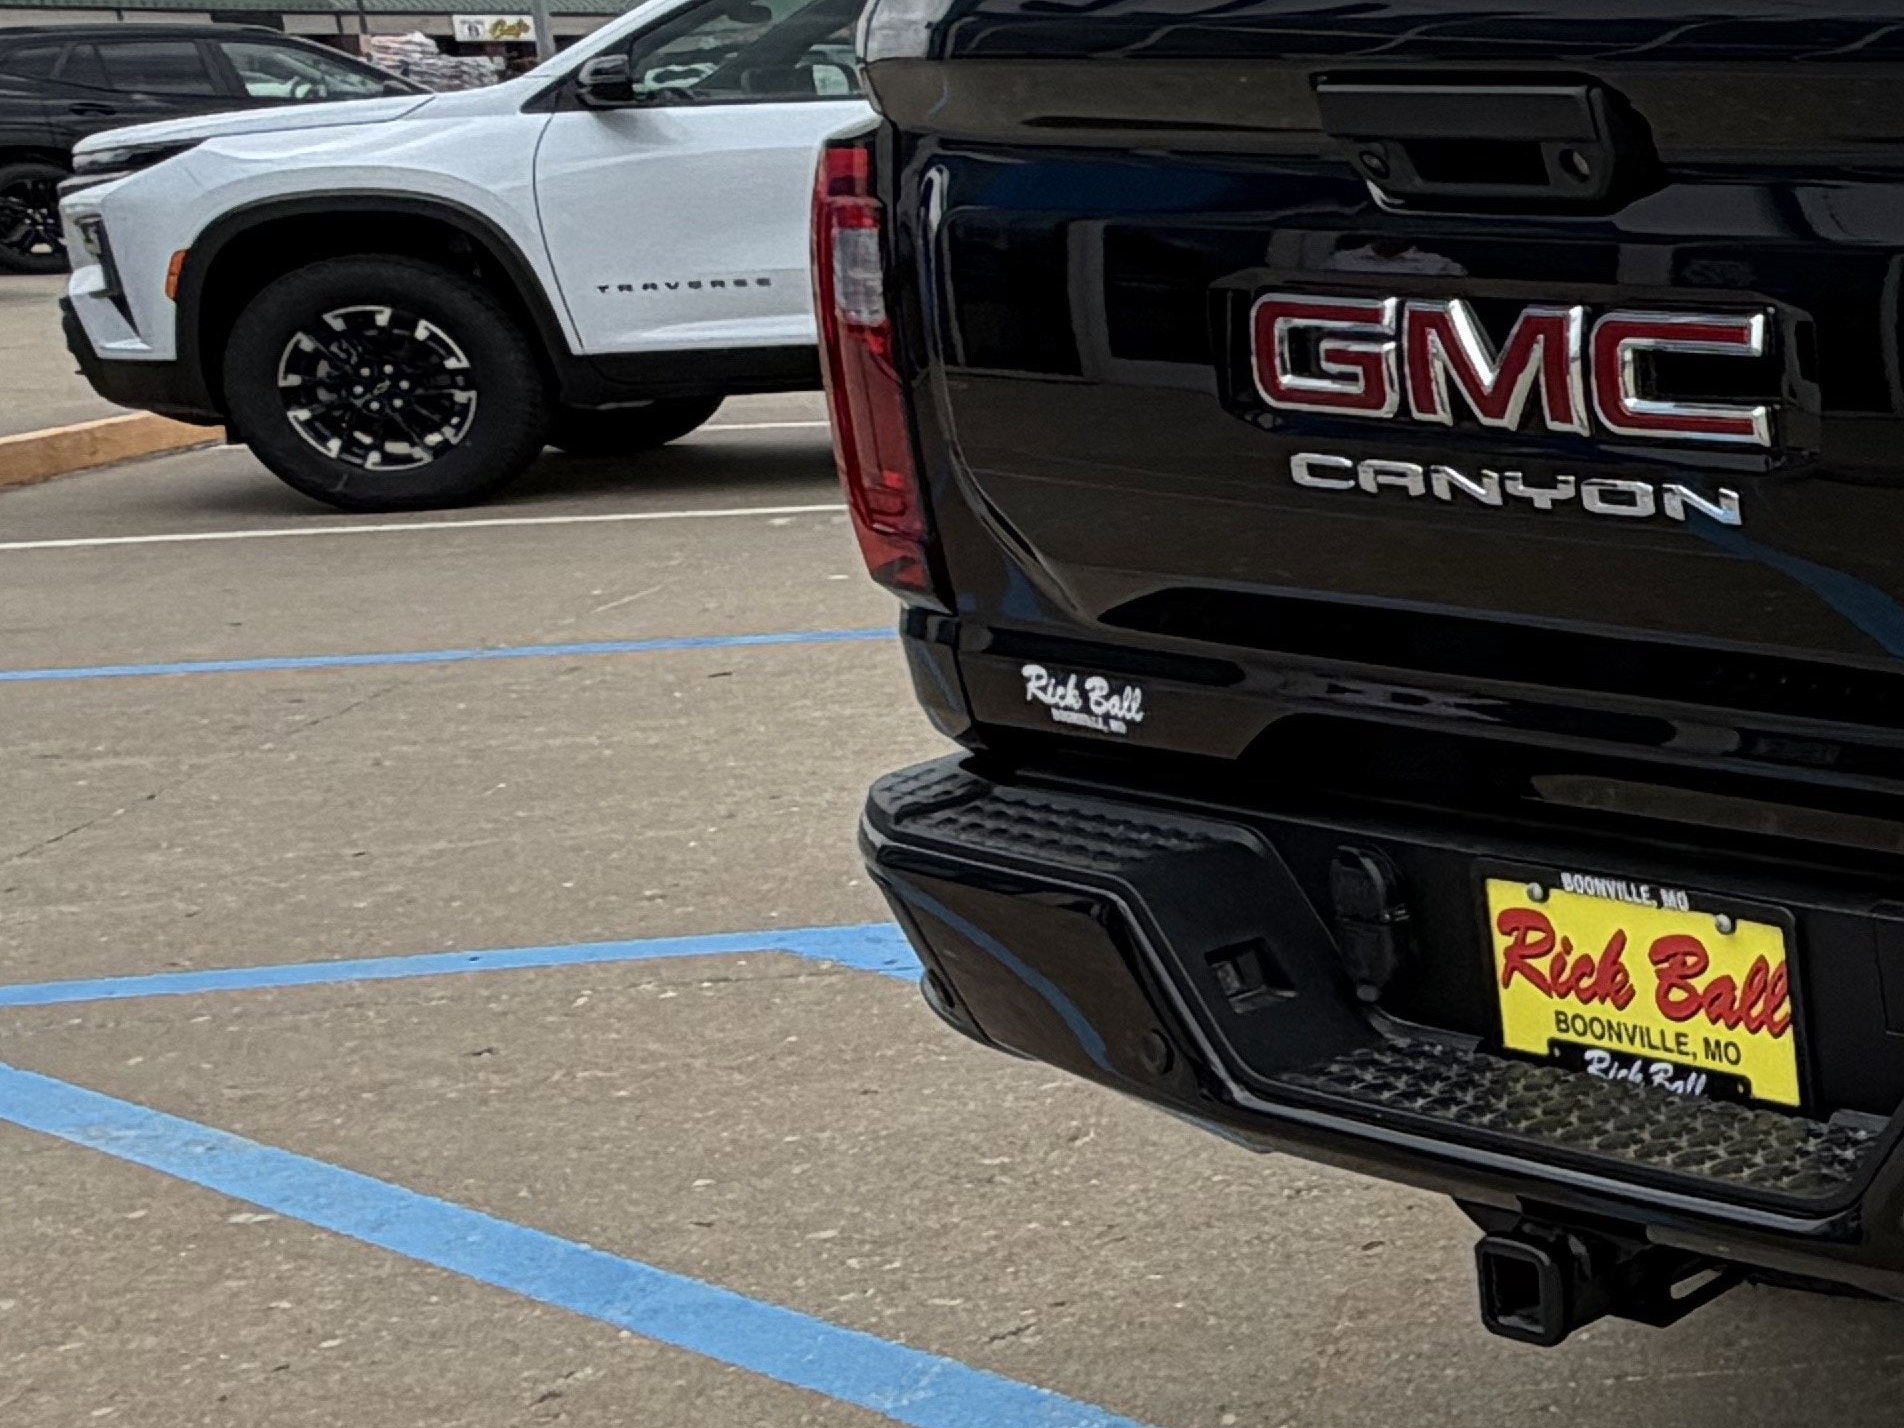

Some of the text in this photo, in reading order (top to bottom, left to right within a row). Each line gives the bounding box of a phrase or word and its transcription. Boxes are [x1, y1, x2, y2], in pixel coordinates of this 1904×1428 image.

[597, 278, 772, 293] TRAVERSE
[1250, 292, 1772, 448] GMC
[1290, 451, 1743, 526] CANYON
[1021, 664, 1082, 710] Rick
[1084, 676, 1145, 722] Ball
[1561, 872, 1690, 912] BOONVILLE, MO
[1497, 907, 1792, 1038] Rick Ball
[1554, 1010, 1742, 1066] BOONVILLE, MO
